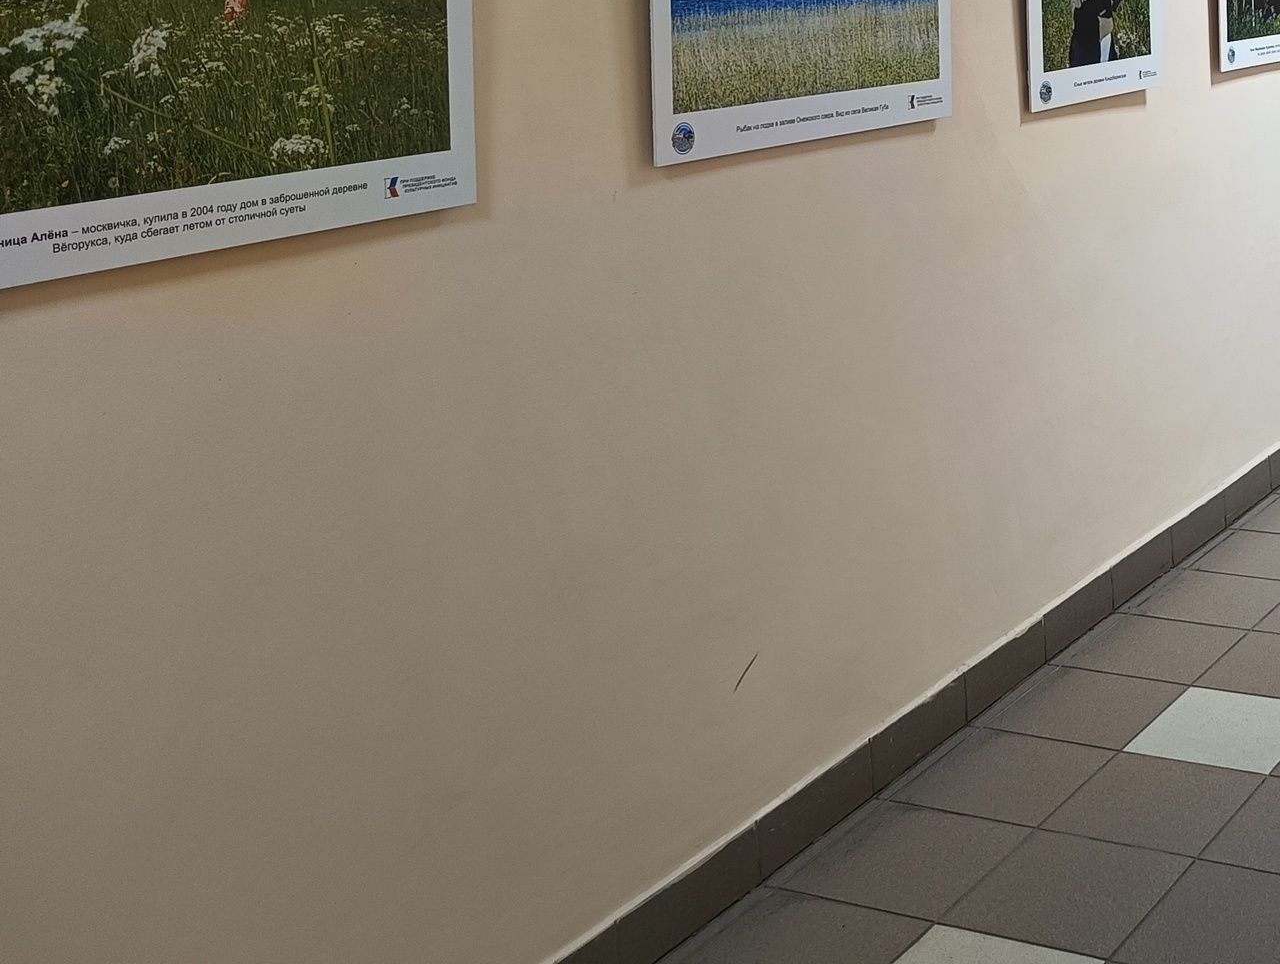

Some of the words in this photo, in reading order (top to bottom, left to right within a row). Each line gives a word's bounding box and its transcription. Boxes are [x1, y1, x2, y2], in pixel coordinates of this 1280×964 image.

[30, 229, 69, 243] Алёна
[81, 218, 140, 235] москвичка,
[143, 212, 179, 226] купила
[181, 210, 188, 219] в
[190, 204, 214, 217] 2004
[216, 202, 238, 214] году
[239, 199, 259, 211] дом
[261, 198, 267, 206] в
[269, 187, 330, 204] заброшенной
[331, 182, 368, 196] деревне
[52, 237, 111, 254] Вёгорукса,
[114, 232, 138, 245] куда
[140, 225, 180, 239] сбегает
[182, 220, 213, 232] летом
[214, 217, 226, 227] от
[228, 207, 278, 224] столичной
[279, 204, 306, 217] суеты
